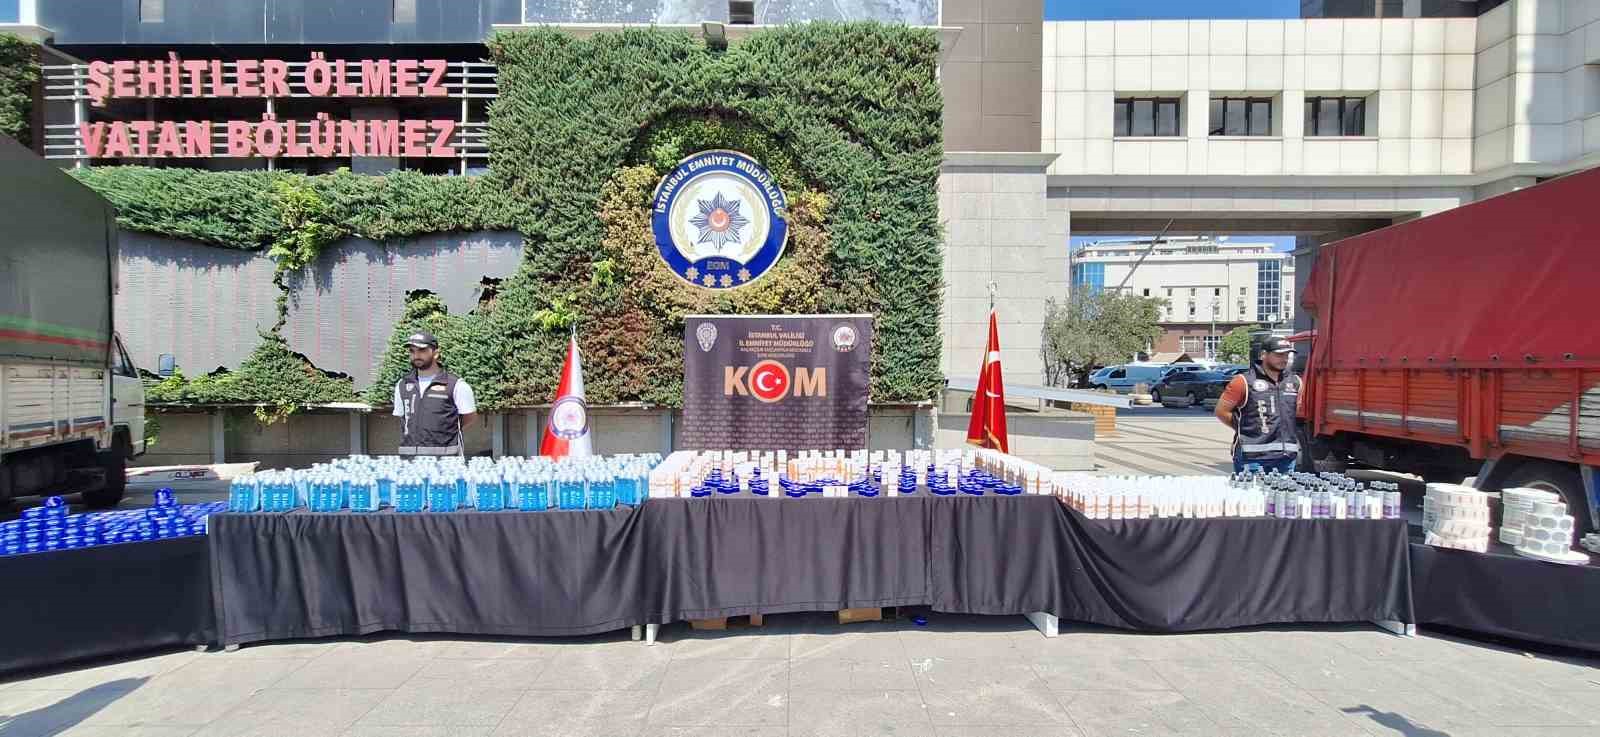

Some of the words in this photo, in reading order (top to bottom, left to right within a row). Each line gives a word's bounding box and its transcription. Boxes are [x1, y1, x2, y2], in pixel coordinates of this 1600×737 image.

[86, 51, 291, 107] ŞEHİTLER
[303, 51, 449, 97] ÖLMEZ
[79, 120, 212, 158] VATAN
[226, 112, 458, 158] BÖLÜNMEZ
[655, 171, 688, 213] İSTANBUL
[689, 155, 735, 172] EMNİYET
[724, 360, 826, 402] KOM
